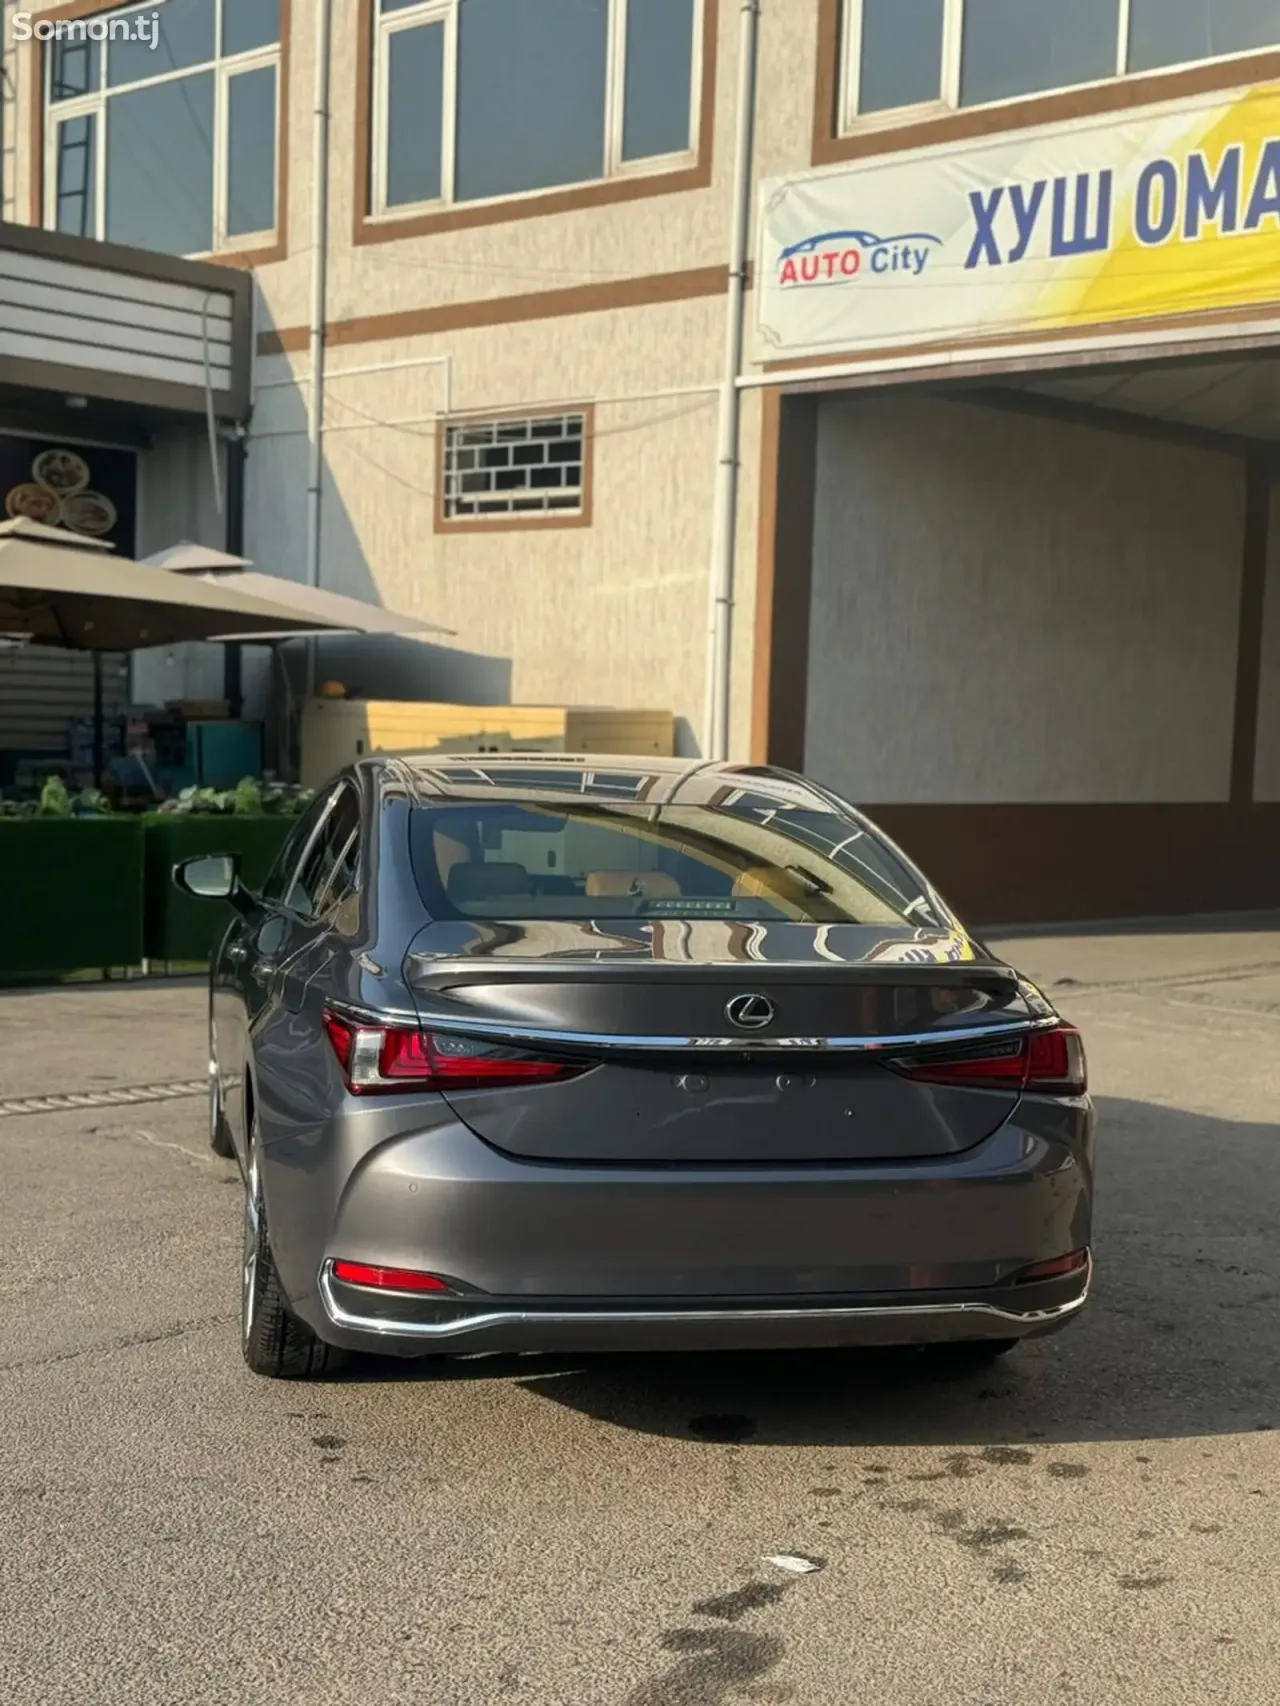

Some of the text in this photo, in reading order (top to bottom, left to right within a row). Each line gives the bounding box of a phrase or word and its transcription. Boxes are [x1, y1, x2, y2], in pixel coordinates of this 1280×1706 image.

[964, 140, 1280, 269] ХУШ ОМА
[779, 244, 930, 285] AUTO City
